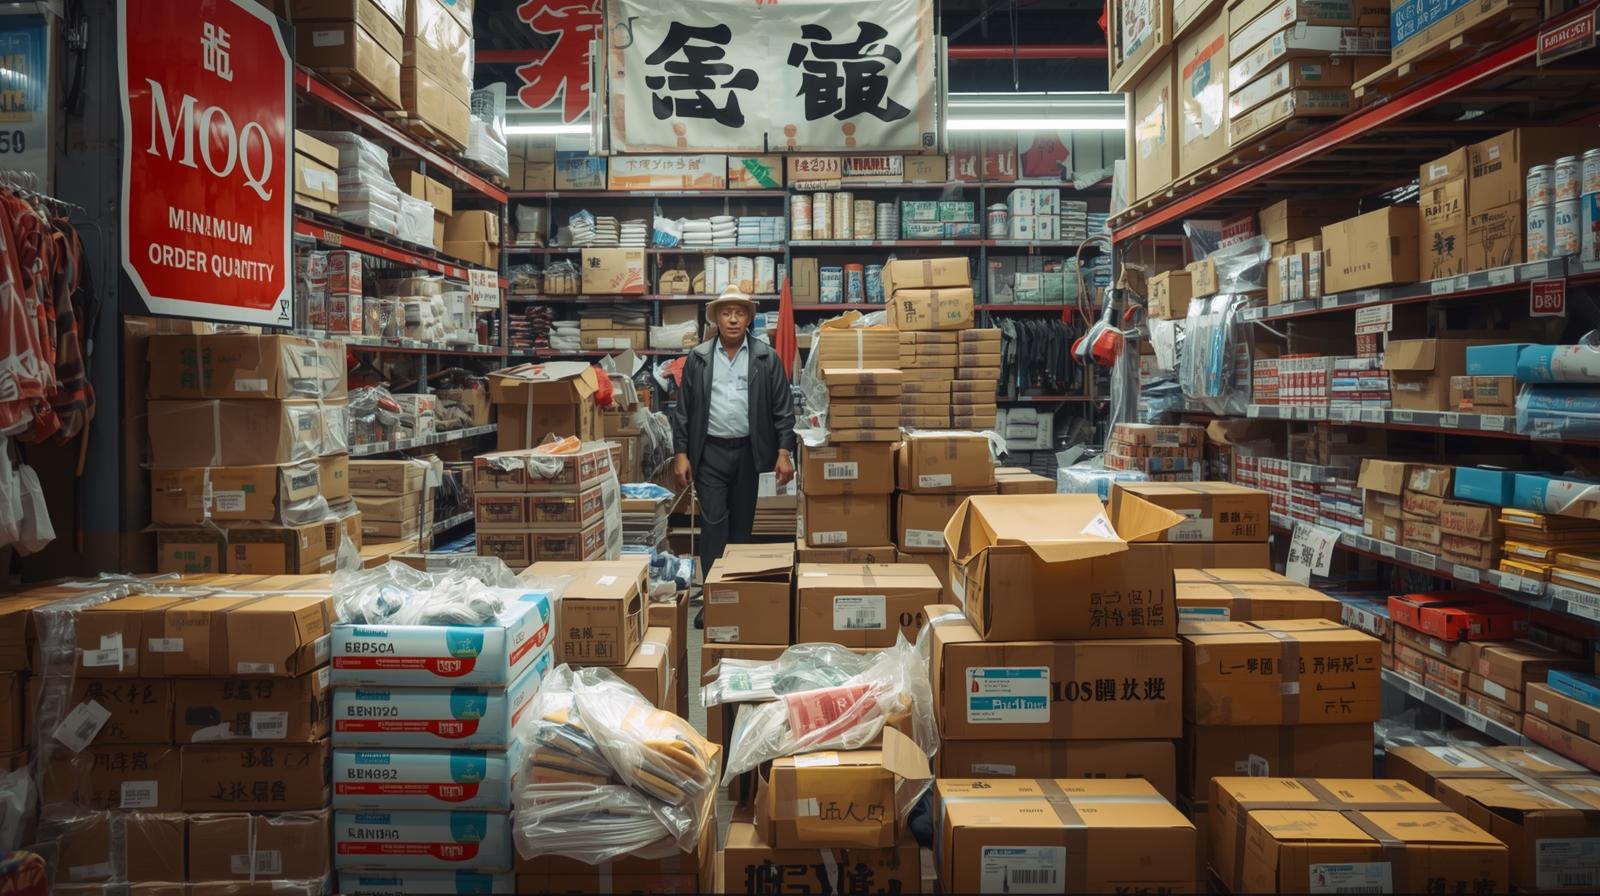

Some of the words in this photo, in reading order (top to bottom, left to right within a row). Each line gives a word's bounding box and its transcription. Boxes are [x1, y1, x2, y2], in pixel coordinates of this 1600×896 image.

[145, 78, 273, 201] MOQ
[168, 206, 253, 246] MINIMUM
[148, 242, 208, 273] ORDER
